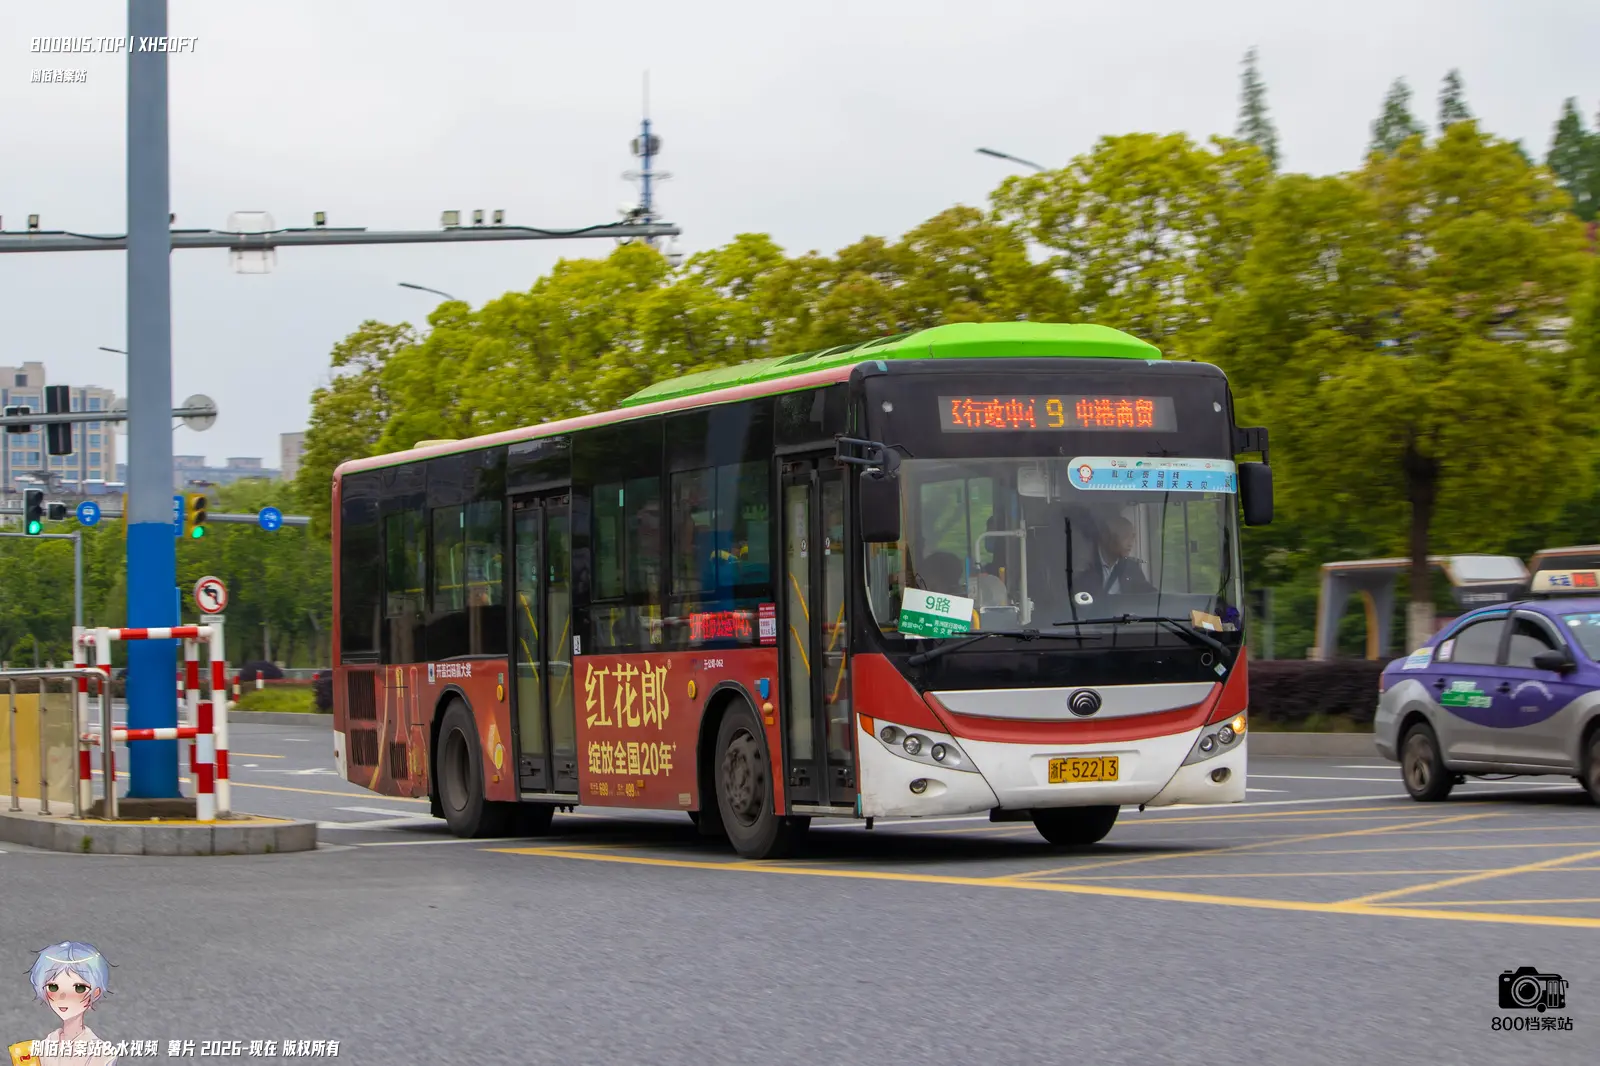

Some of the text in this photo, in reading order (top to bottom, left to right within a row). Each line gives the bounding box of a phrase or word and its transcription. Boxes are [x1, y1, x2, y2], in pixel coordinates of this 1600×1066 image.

[1046, 399, 1065, 428] 9
[1075, 398, 1154, 428] 中港商贸
[925, 595, 951, 614] 9路
[584, 659, 670, 730] 红花郎
